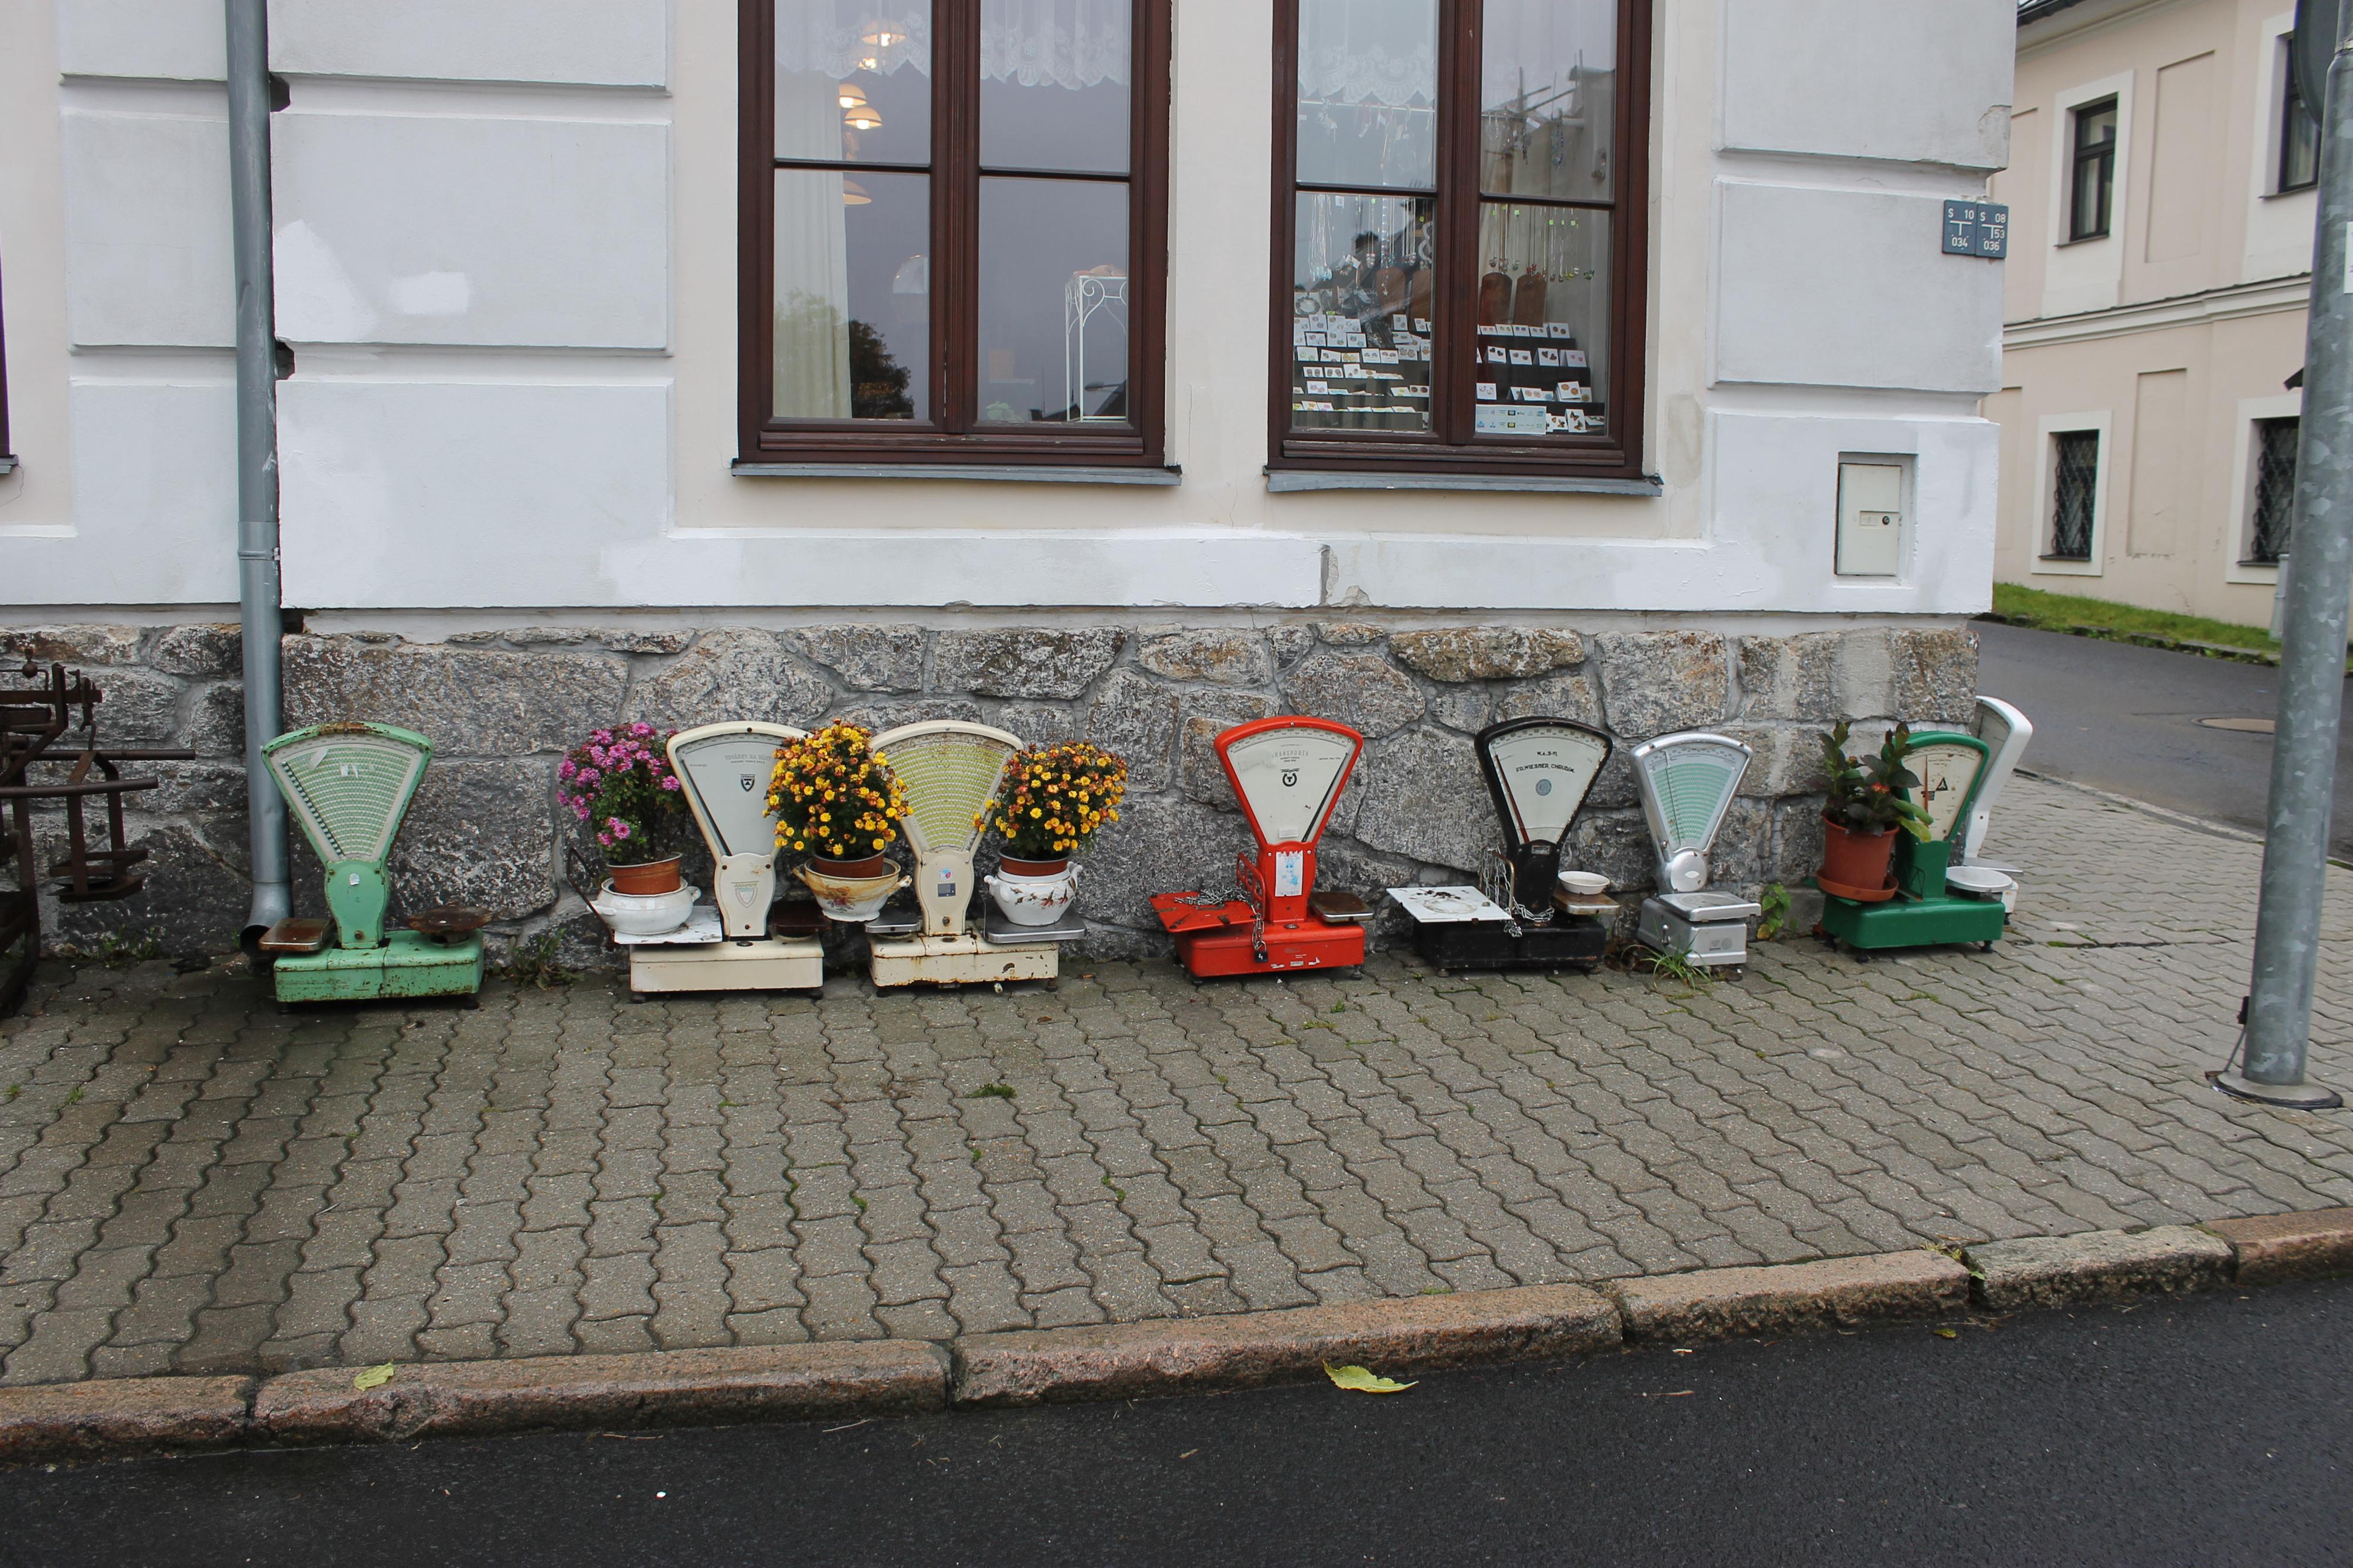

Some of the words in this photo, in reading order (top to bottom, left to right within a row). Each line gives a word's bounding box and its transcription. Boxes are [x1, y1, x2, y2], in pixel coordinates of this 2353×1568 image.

[1948, 208, 1954, 218] S
[1965, 209, 1974, 219] 10
[1980, 212, 1985, 221] S
[1995, 213, 2006, 223] 08
[1994, 229, 2005, 239] 53
